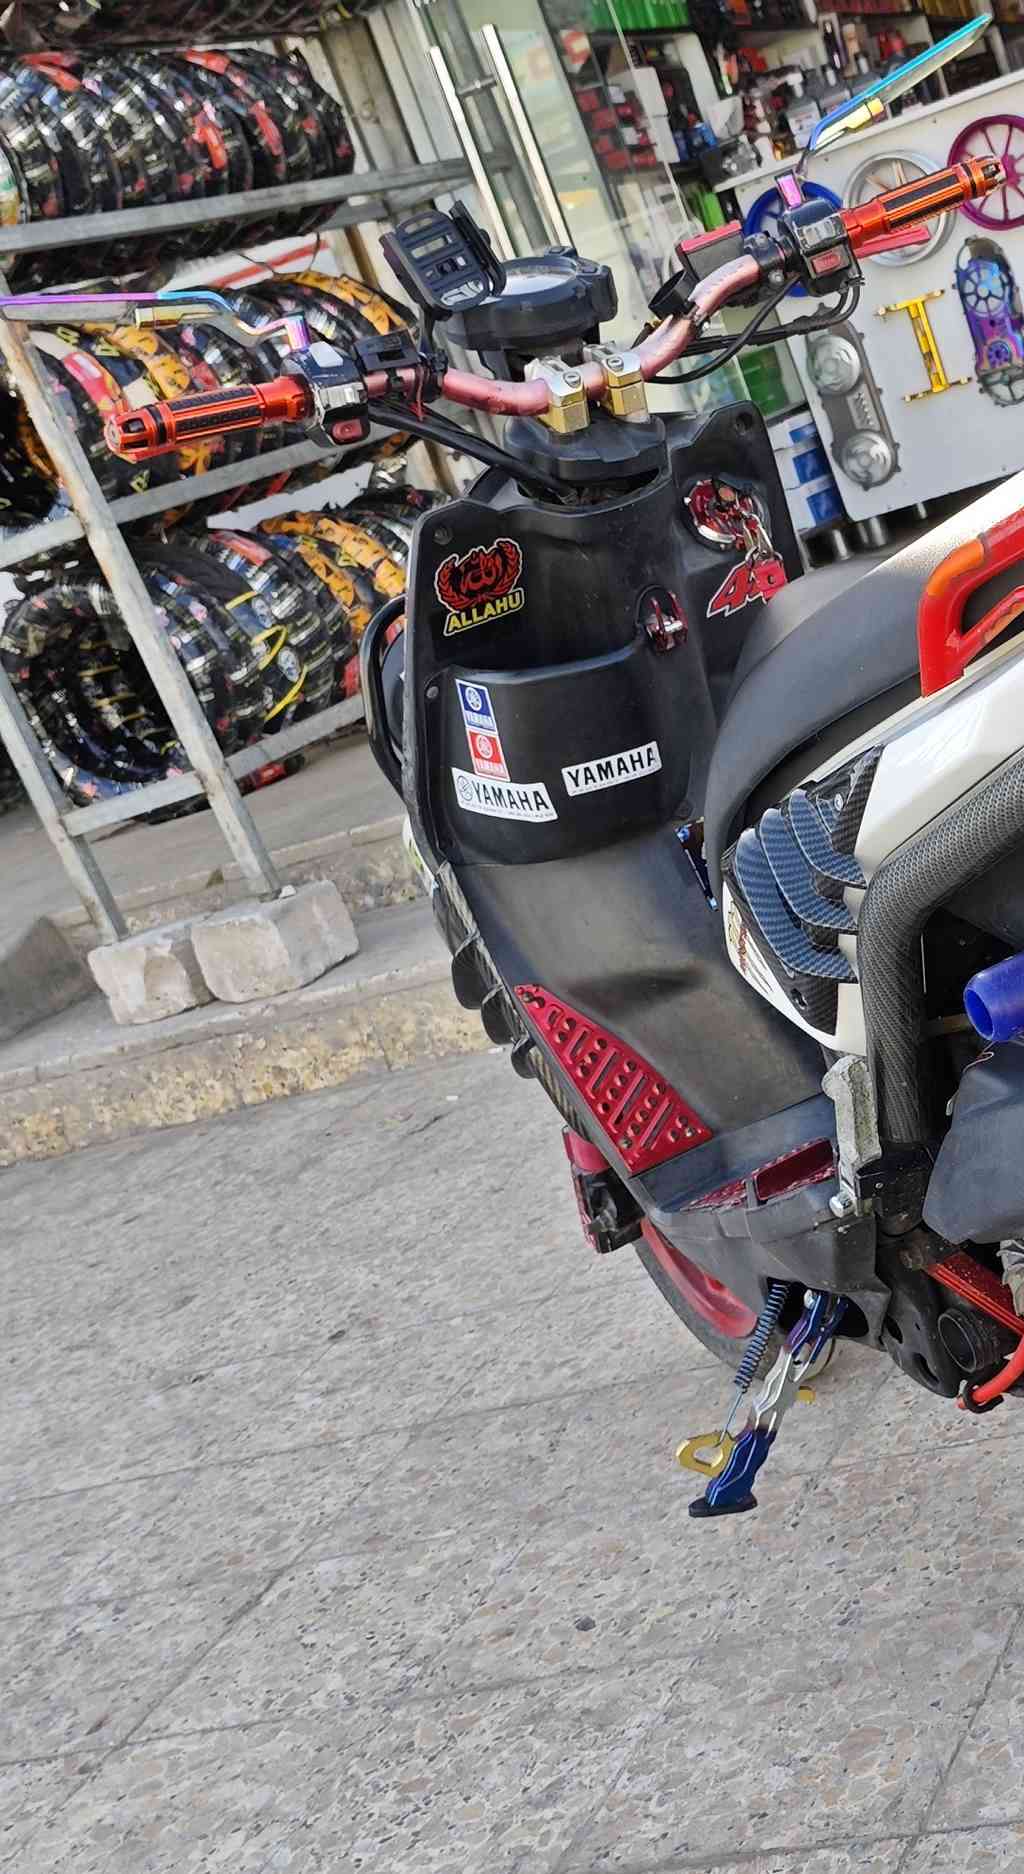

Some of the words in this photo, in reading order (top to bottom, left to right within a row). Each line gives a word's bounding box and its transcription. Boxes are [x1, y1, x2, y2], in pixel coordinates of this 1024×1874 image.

[447, 592, 522, 634] ALLAHU
[567, 748, 657, 788] YAMAHA
[472, 779, 549, 812] YAMAHA
